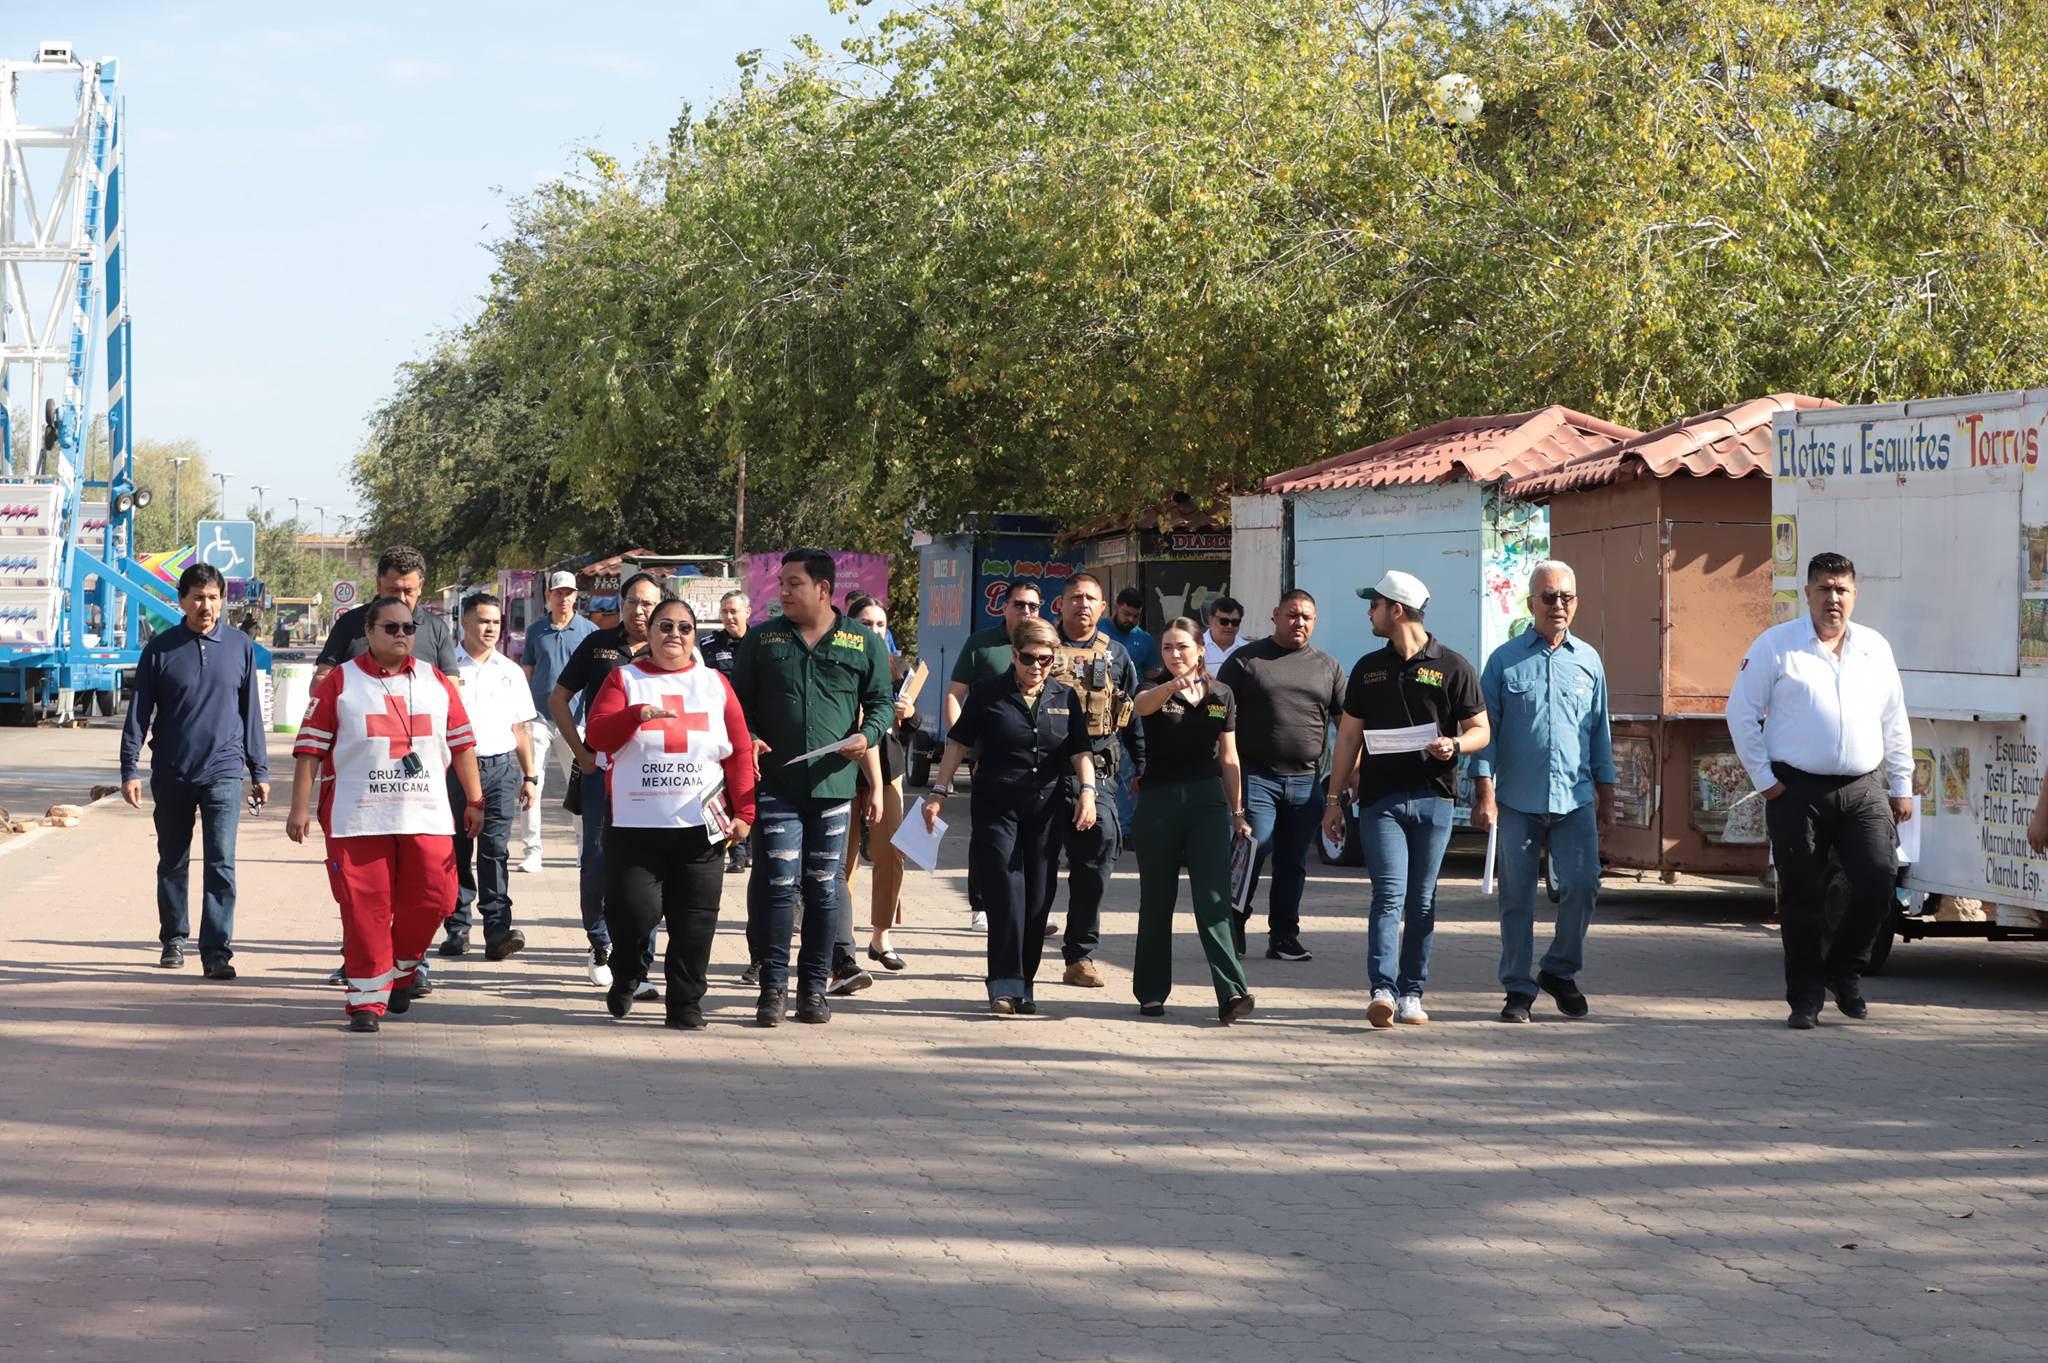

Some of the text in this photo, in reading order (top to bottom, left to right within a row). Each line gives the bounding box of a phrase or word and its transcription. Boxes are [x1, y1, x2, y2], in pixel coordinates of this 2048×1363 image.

[1778, 429, 1836, 477] Elotes
[338, 586, 351, 597] 20
[1995, 733, 2037, 768] Esquites
[368, 769, 401, 780] CRUZ
[642, 763, 673, 774] CRUZ
[1985, 764, 2007, 792] Tosti
[369, 782, 430, 794] MEXICANA
[642, 776, 704, 788] MEXICANA
[1984, 795, 2007, 824] Elote
[1986, 857, 2042, 898] Charola Esp.
